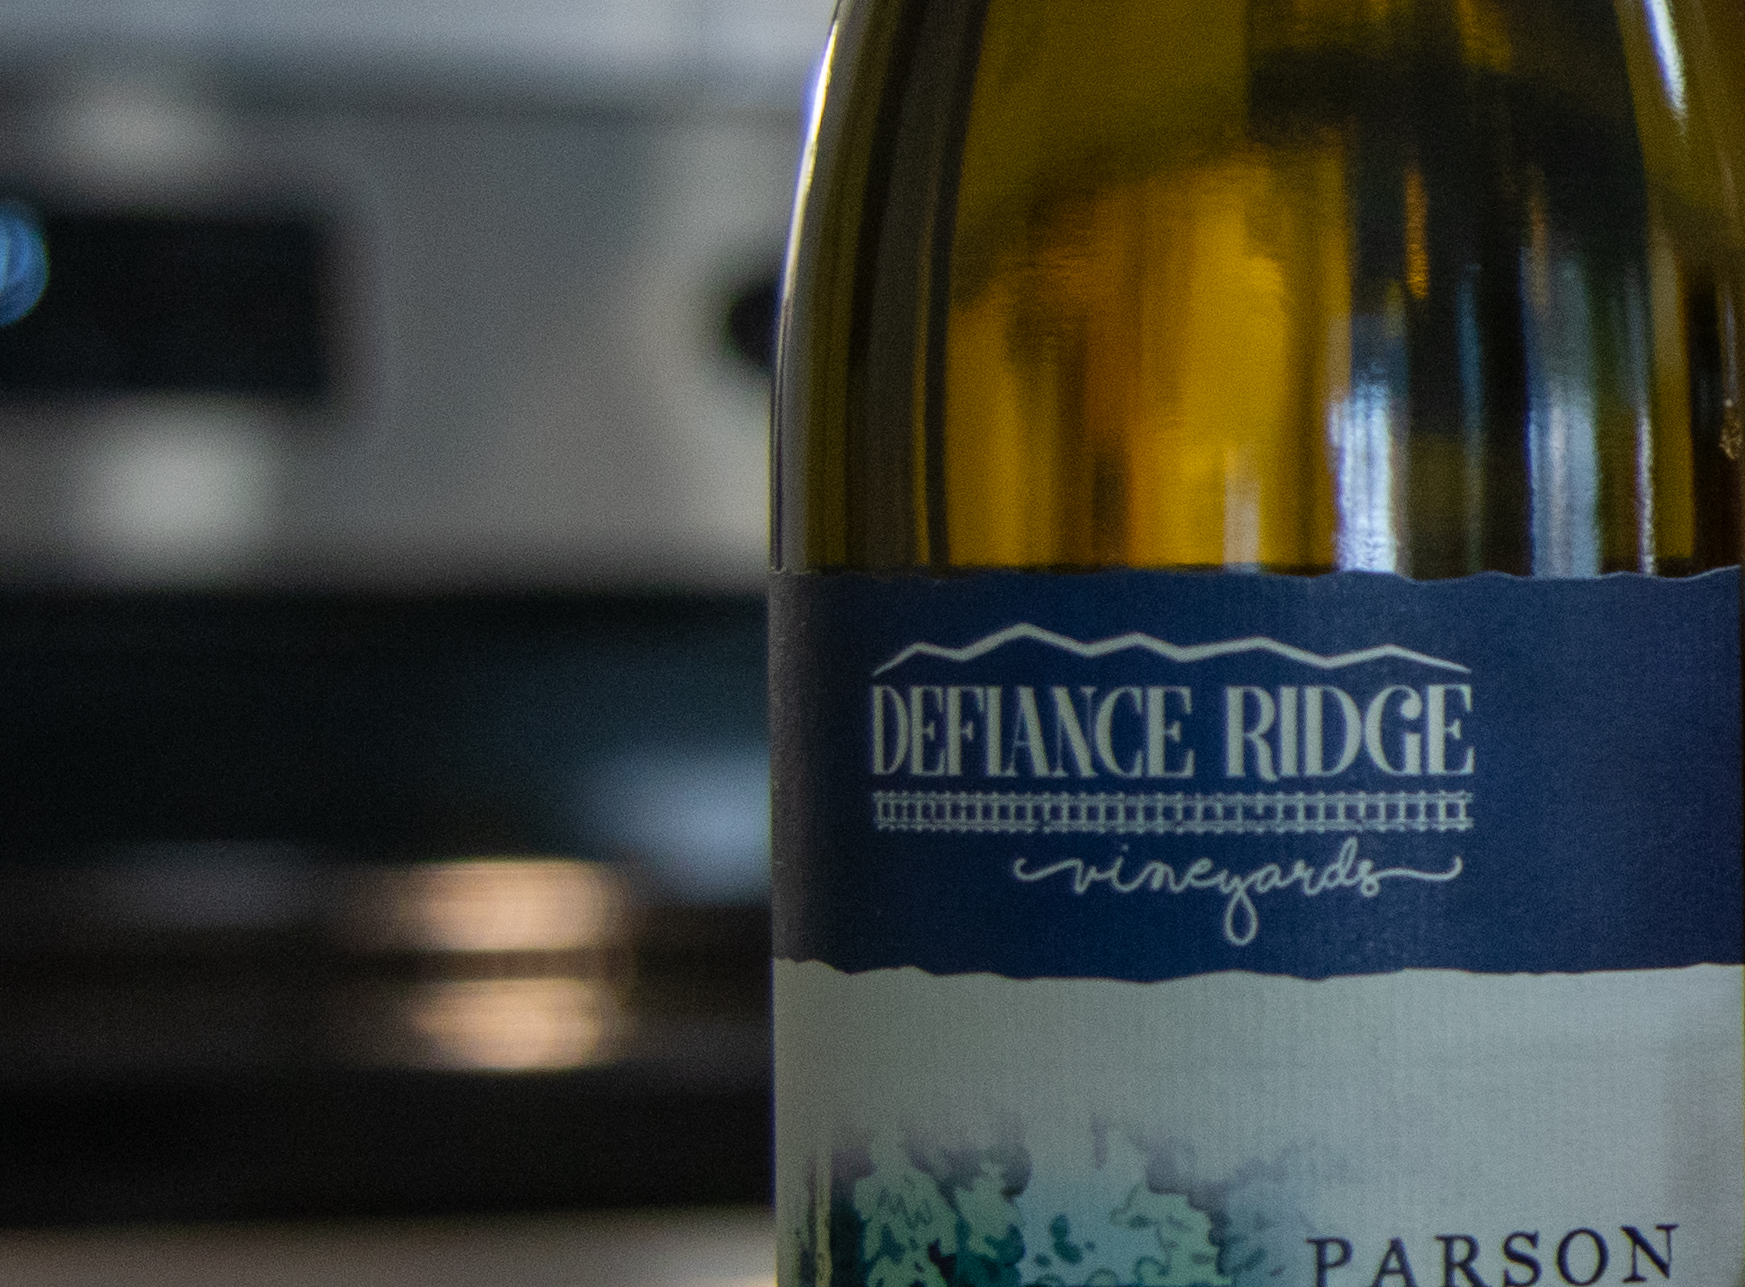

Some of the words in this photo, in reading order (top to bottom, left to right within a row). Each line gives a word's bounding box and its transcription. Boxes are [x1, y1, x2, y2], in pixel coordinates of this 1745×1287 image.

[870, 683, 1196, 780] DEFIANCE
[1225, 683, 1475, 781] RIDGE
[1013, 837, 1463, 946] vineyards
